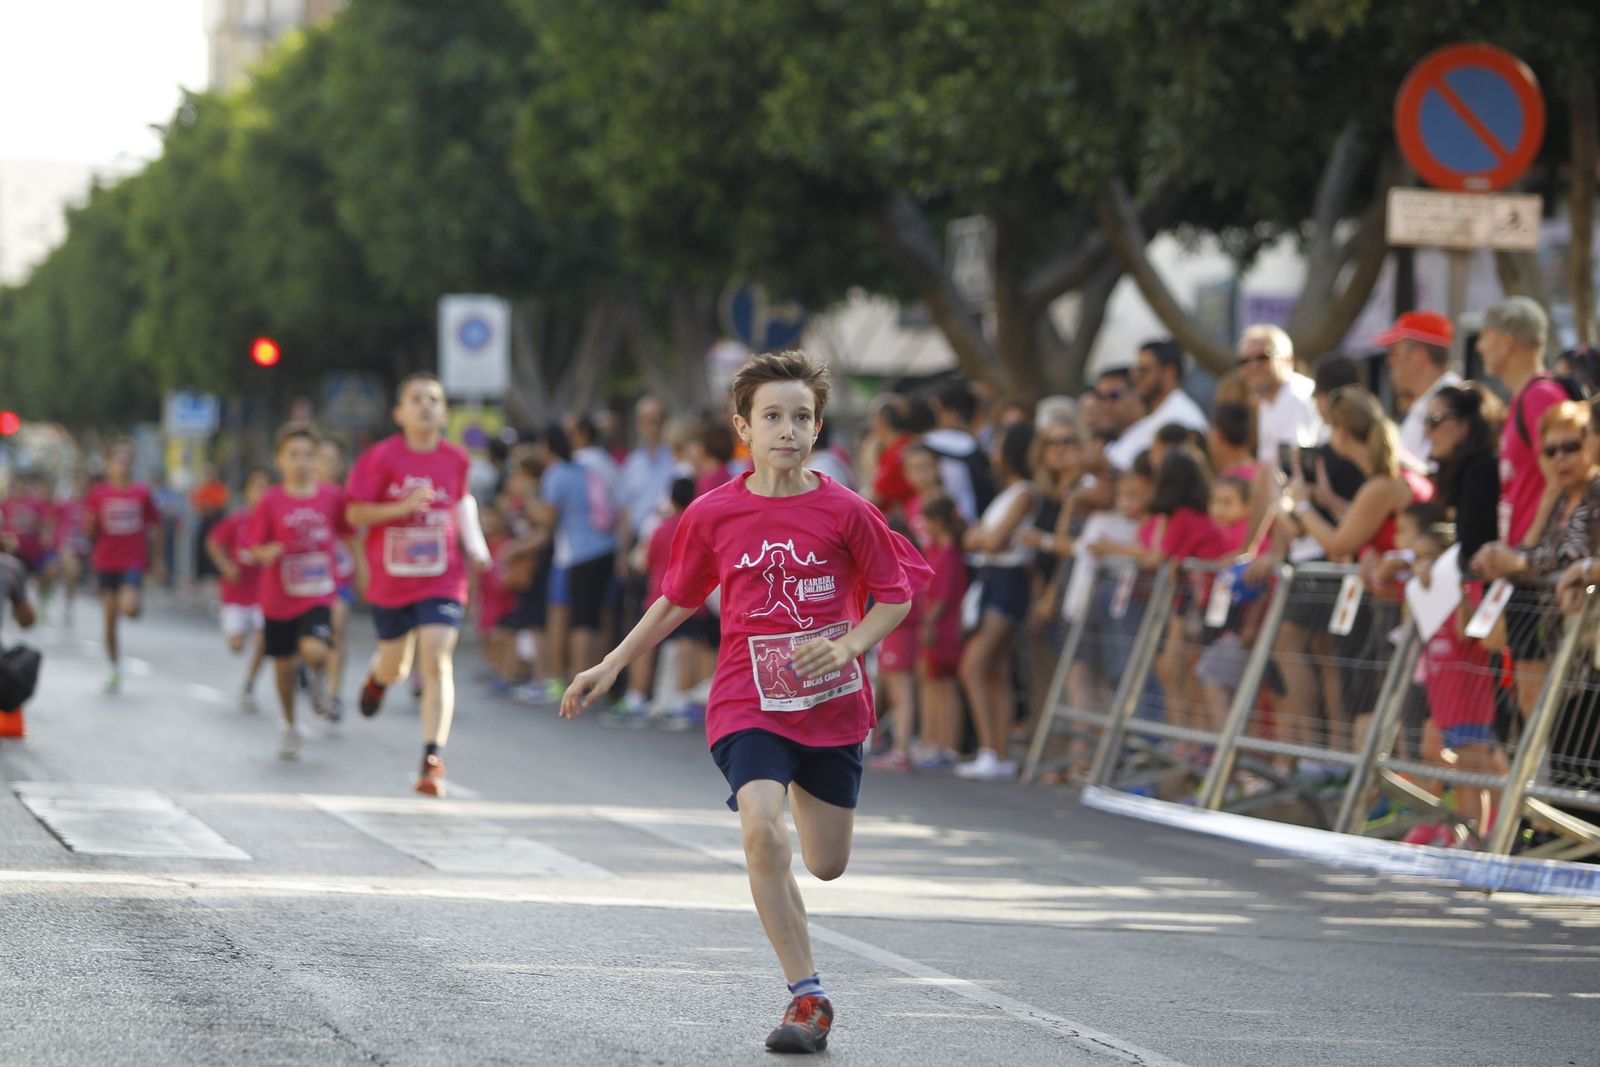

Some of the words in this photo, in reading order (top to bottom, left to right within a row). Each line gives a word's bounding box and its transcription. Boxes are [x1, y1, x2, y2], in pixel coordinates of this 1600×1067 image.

[804, 575, 835, 586] CARRERA
[794, 578, 806, 602] 4
[803, 676, 824, 689] LUCAS
